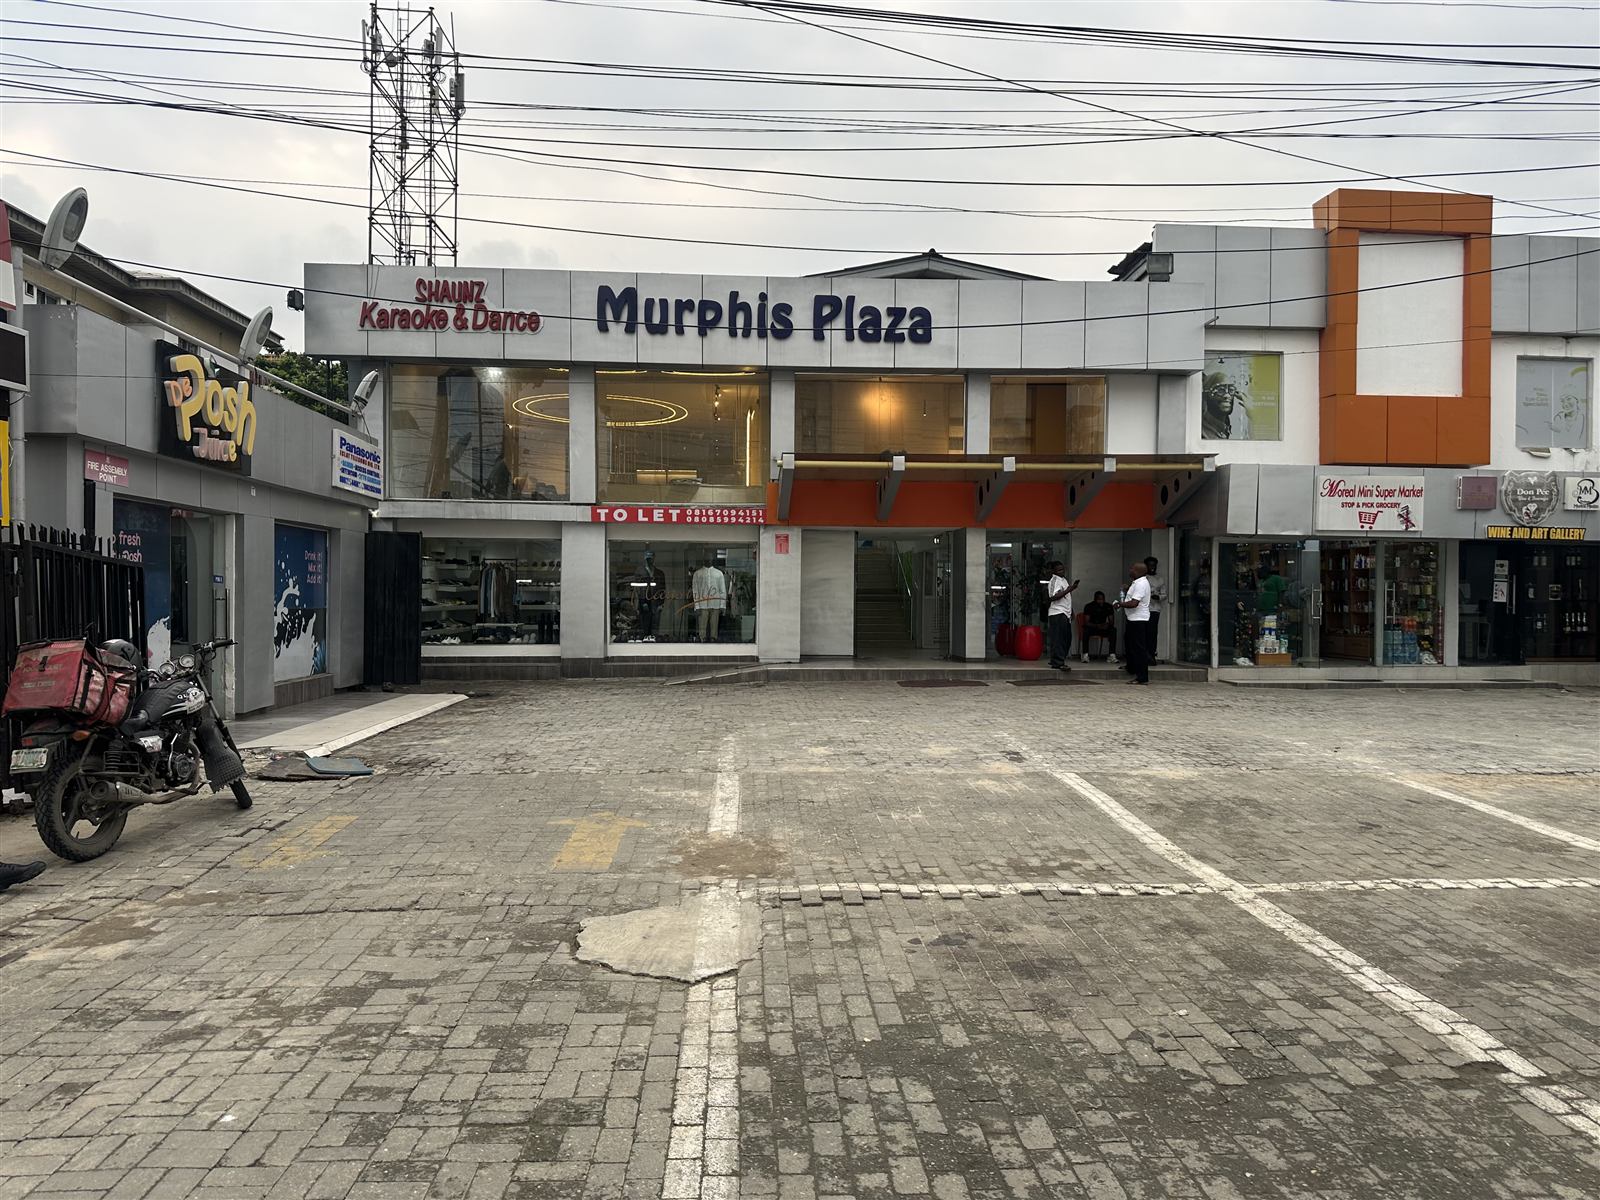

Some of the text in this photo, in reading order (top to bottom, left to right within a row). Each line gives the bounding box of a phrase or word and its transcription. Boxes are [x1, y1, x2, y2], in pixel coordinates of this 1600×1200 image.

[414, 277, 486, 303] SHAUNZ
[359, 301, 541, 332] Karaoke & Dance
[596, 285, 933, 344] Murphis Plaza
[170, 354, 257, 456] Posh
[193, 427, 238, 462] Juice
[340, 436, 381, 464] Panasonic
[87, 460, 128, 477] FIRE ASSEMBLY
[99, 472, 117, 483] POINT
[1319, 478, 1424, 500] Moreal Mini Super Market
[1517, 488, 1534, 496] Don
[1341, 501, 1355, 509] STOP
[597, 508, 681, 522] TO LET
[119, 530, 141, 546] fresh
[1488, 526, 1586, 540] WINE AND ART GALLERY
